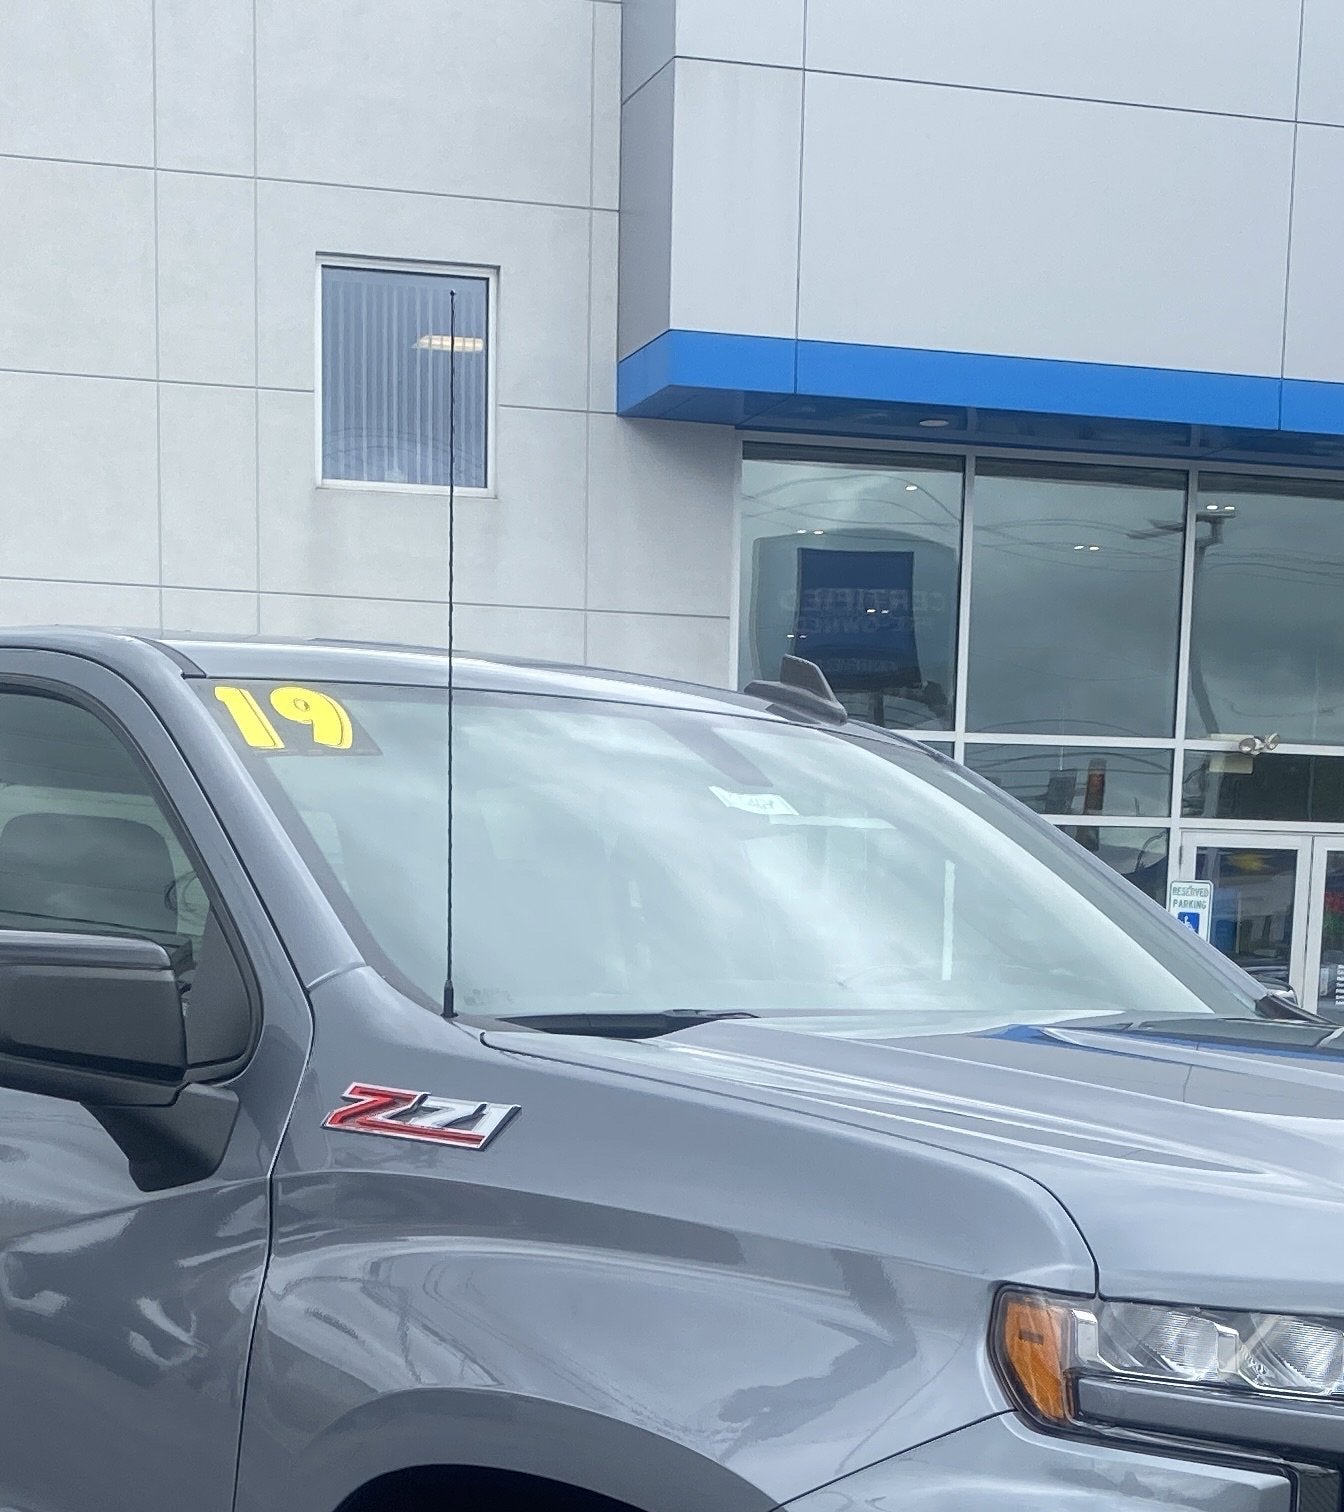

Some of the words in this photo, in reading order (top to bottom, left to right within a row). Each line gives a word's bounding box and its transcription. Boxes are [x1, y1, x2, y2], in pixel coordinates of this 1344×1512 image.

[214, 686, 353, 749] 19
[1172, 886, 1209, 897] RESERVED
[1173, 899, 1208, 910] PARKING
[321, 1081, 522, 1150] Z71
